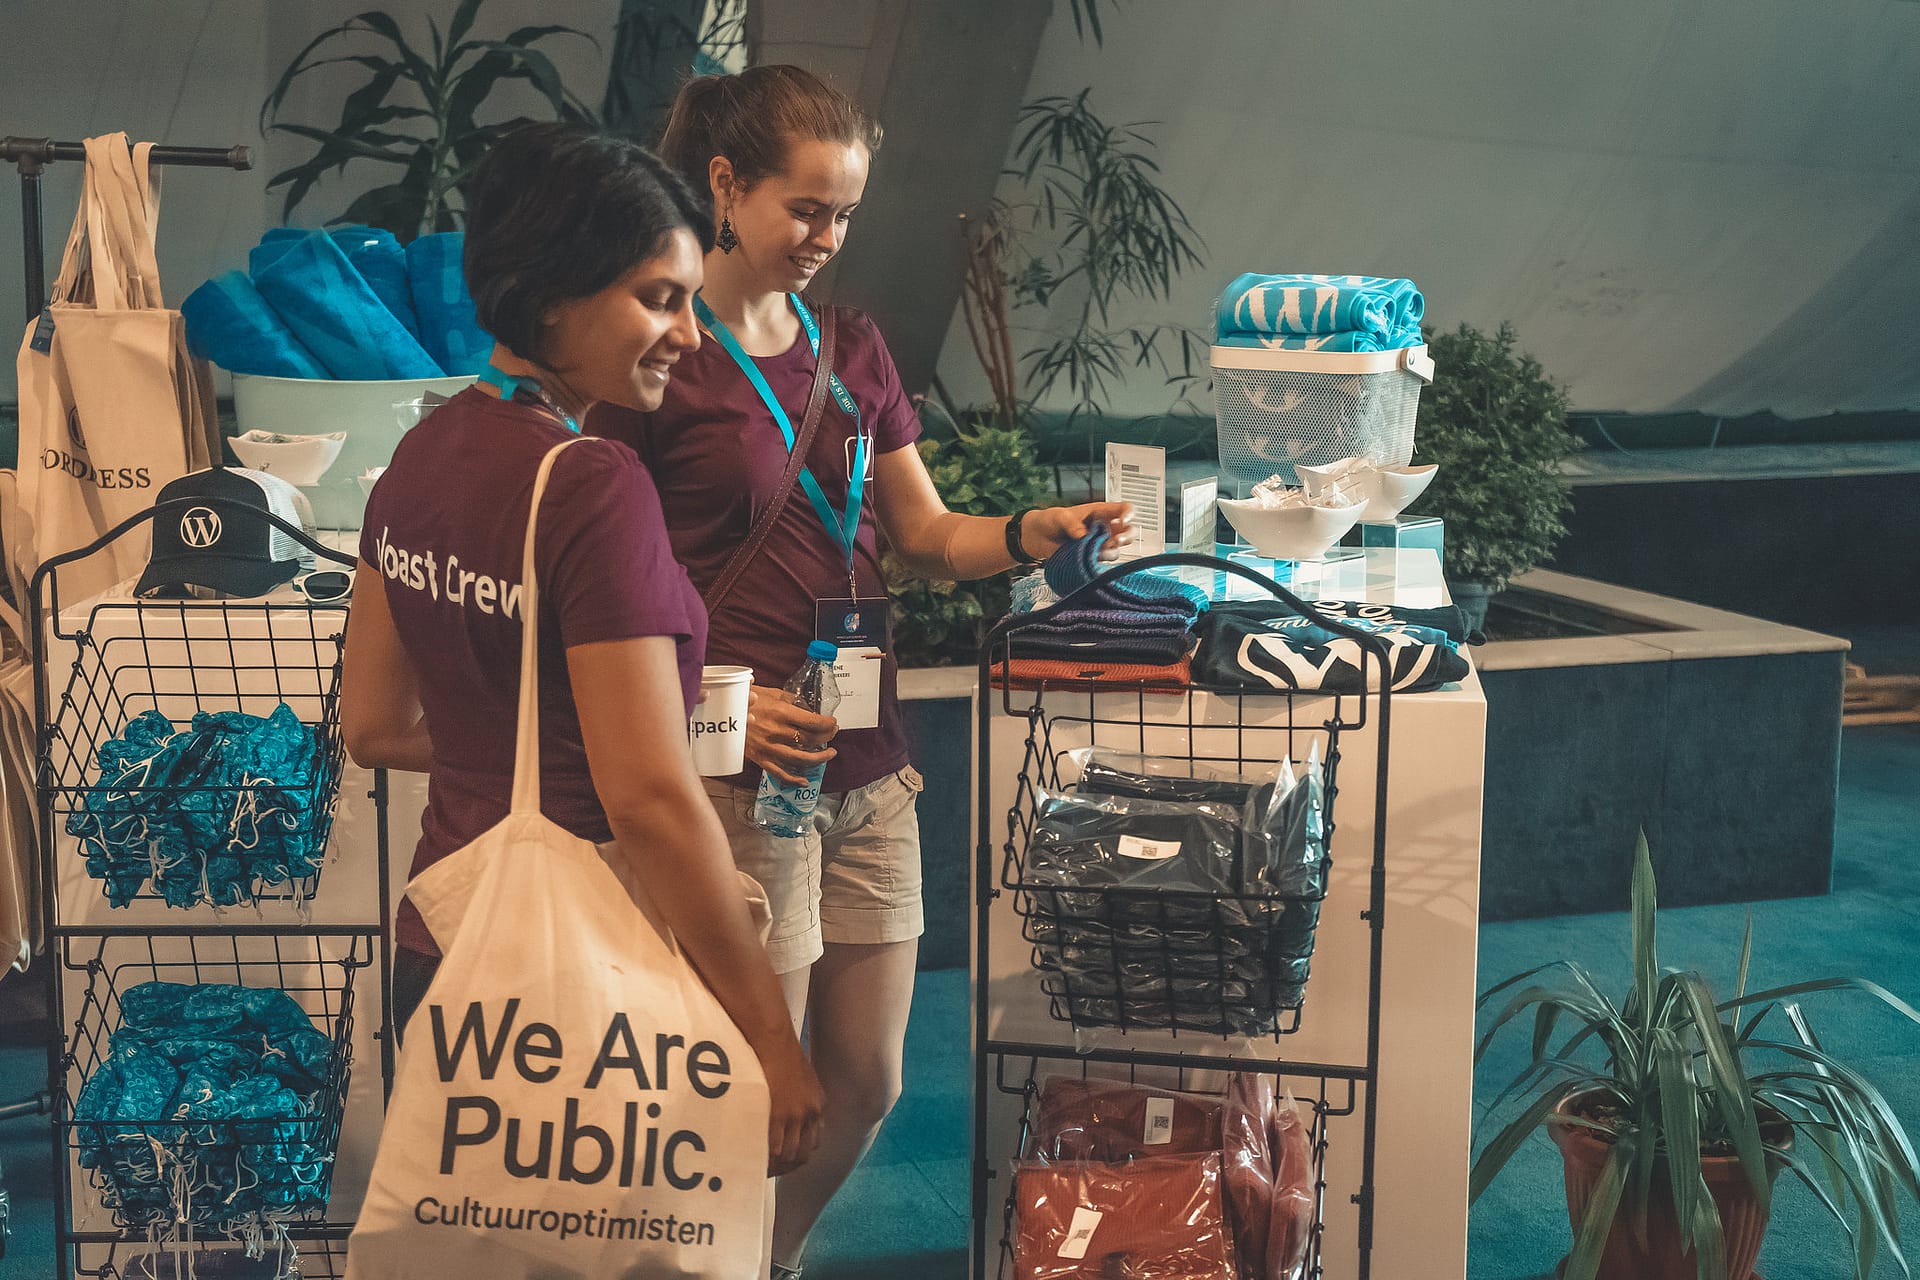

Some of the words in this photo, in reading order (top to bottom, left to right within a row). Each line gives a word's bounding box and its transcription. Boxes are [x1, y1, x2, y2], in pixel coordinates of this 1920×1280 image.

[429, 998, 563, 1084] We
[584, 1012, 731, 1099] Are
[440, 1096, 722, 1192] Public.
[414, 1196, 715, 1246] Cultuuroptimisten
